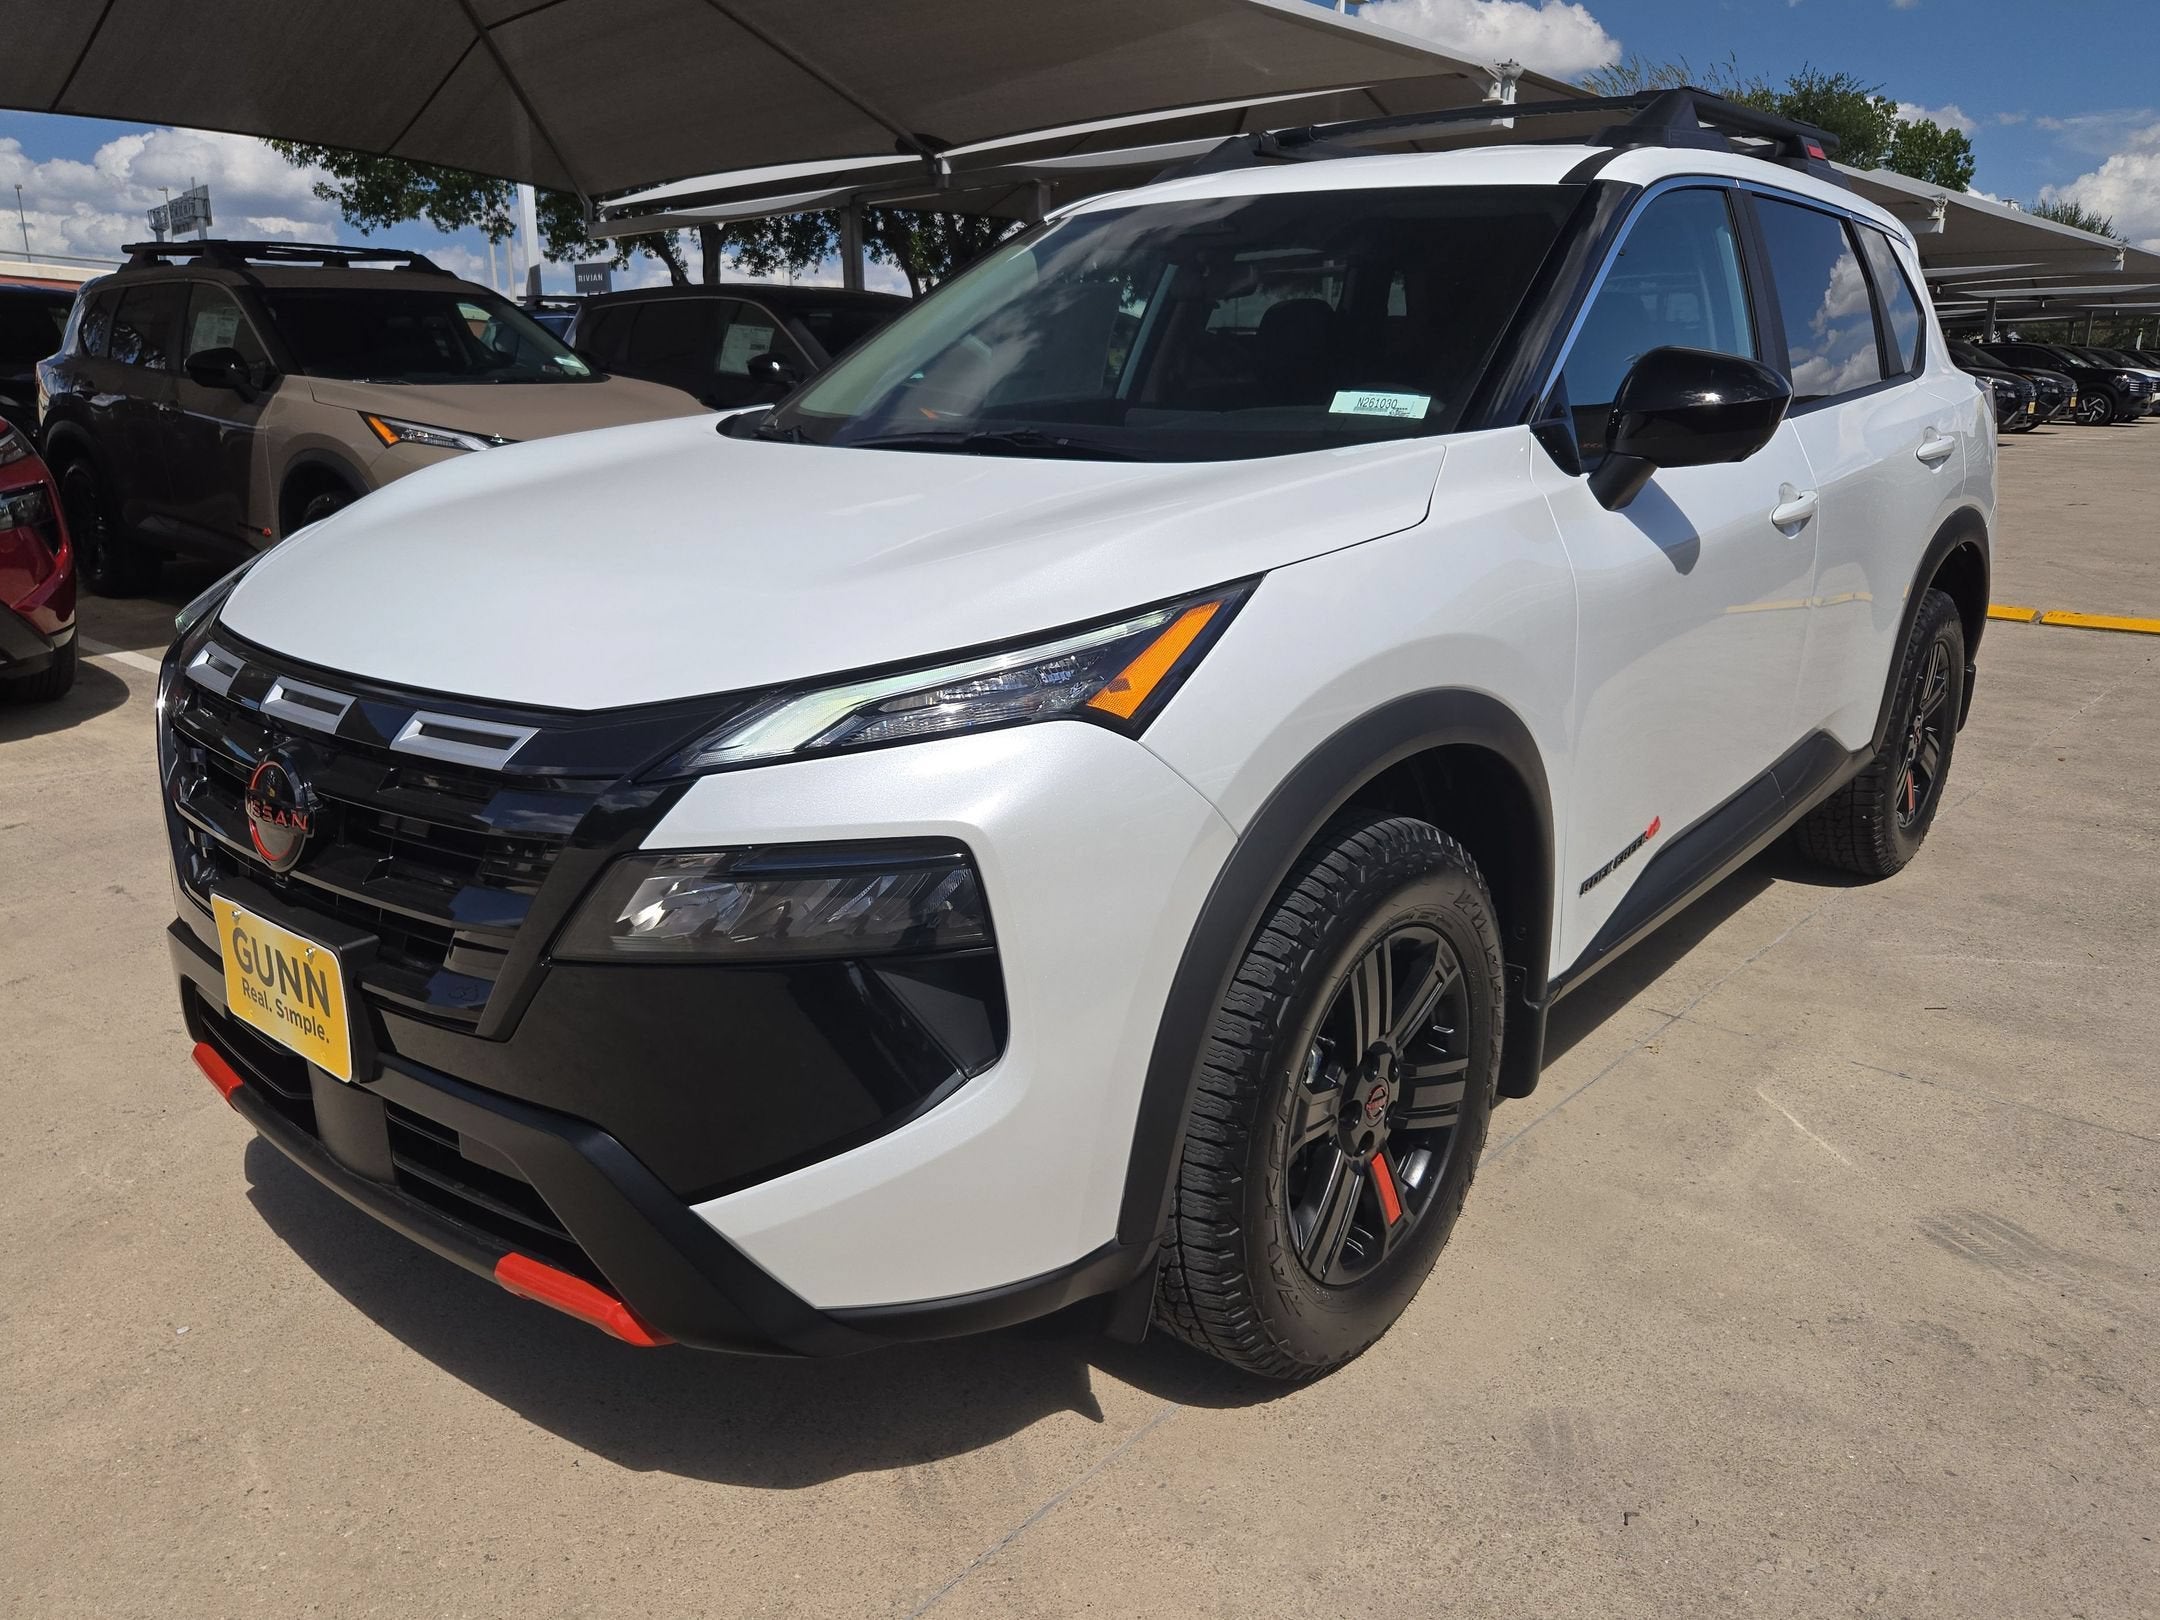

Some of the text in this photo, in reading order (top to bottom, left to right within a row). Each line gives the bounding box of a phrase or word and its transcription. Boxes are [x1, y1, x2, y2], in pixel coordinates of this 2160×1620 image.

[578, 273, 603, 282] RIVIAN
[232, 927, 331, 1018] GUNN
[241, 977, 273, 1013] Real.
